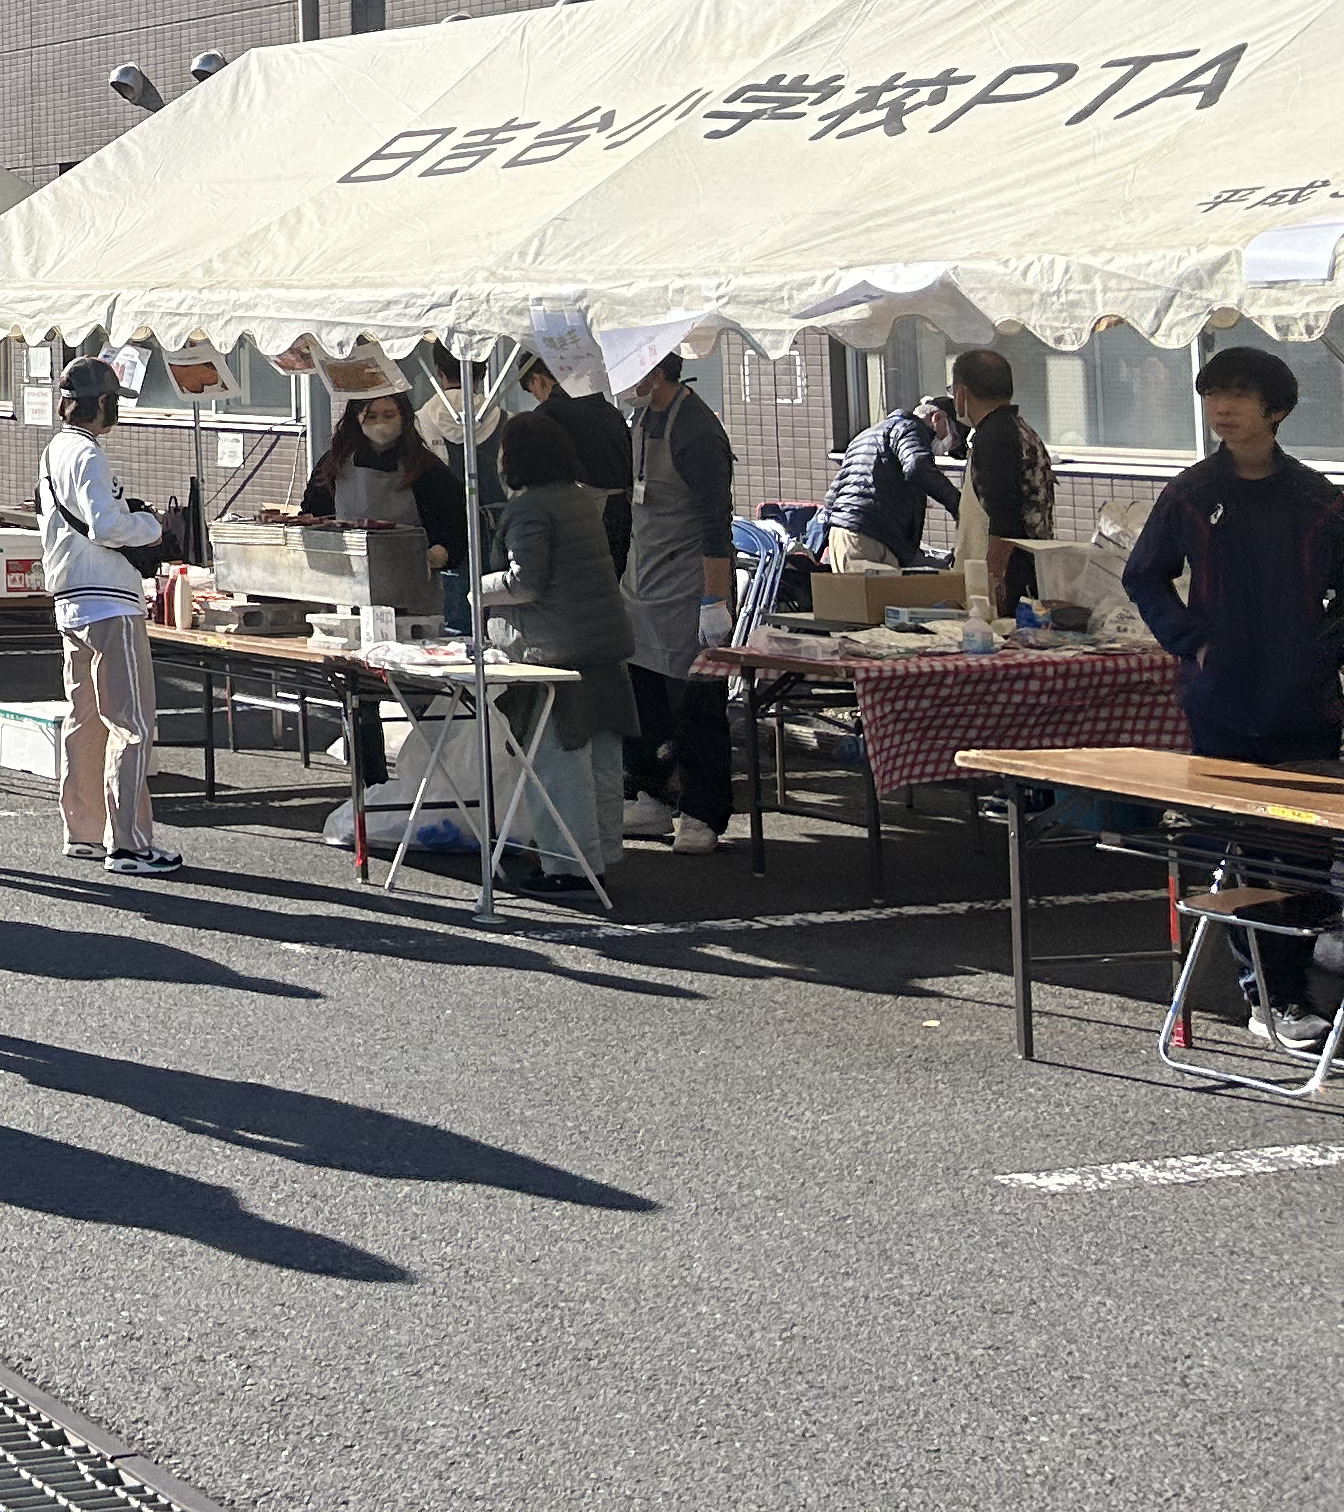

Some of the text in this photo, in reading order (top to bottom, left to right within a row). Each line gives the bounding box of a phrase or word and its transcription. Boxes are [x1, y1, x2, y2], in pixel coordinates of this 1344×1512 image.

[337, 41, 1250, 184] 日吉台小学校PTA
